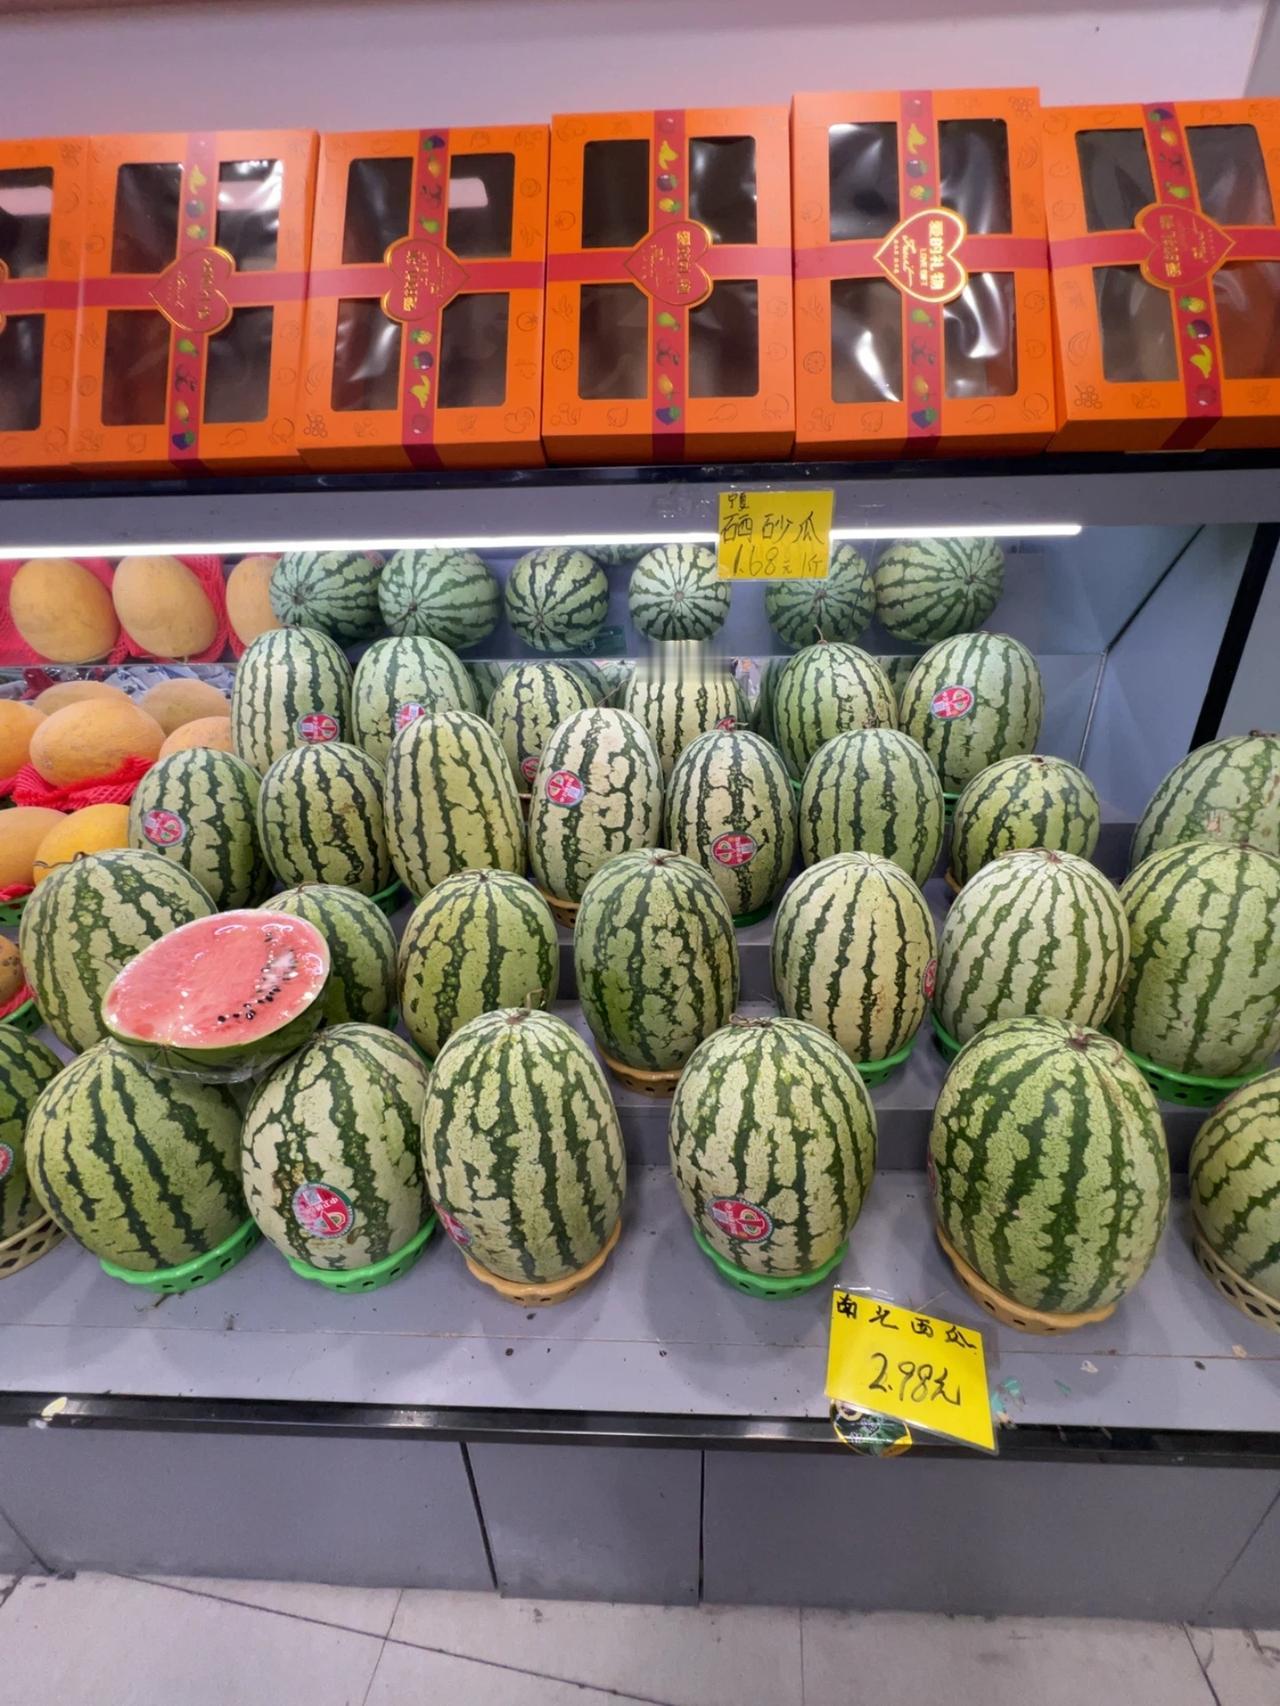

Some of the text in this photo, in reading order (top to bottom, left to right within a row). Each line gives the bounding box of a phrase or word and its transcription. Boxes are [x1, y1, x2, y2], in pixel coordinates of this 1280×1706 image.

[721, 510, 824, 544] 硒砂瓜
[868, 1352, 961, 1406] 2.98元
